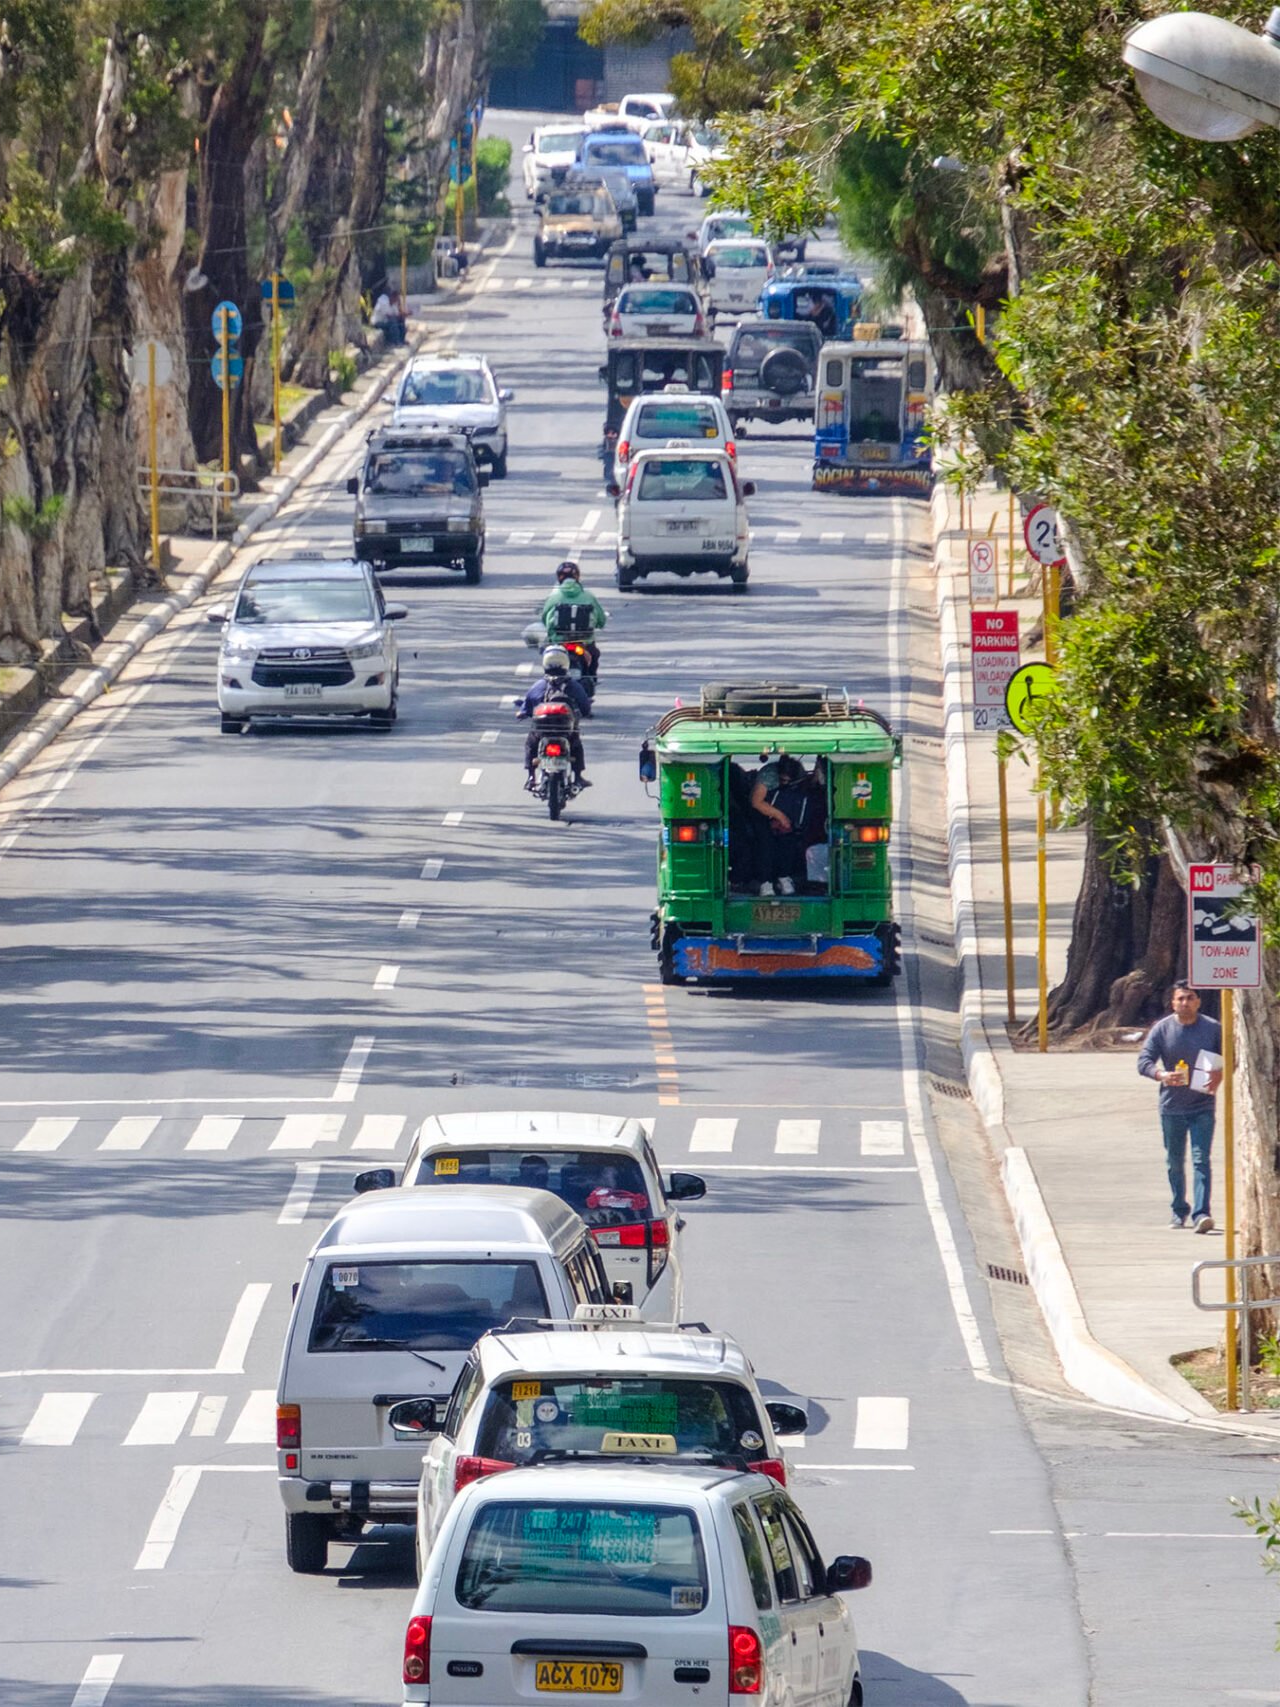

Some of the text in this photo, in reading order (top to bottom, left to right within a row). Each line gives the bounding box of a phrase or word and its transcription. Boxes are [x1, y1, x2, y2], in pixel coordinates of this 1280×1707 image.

[816, 467, 931, 487] SOCIAL DISTANCING
[986, 618, 1004, 630] NO
[975, 635, 1017, 648] PARKING
[976, 656, 1009, 667] LOADING
[976, 671, 1012, 682] UNLOADIN
[975, 708, 988, 726] 20
[1195, 872, 1213, 888] NO
[1200, 945, 1251, 958] TOW-AWAY
[1212, 967, 1239, 979] ZONE
[586, 1308, 629, 1319] TAXI
[517, 1432, 531, 1449] 03
[614, 1436, 661, 1449] TAXI
[674, 1659, 710, 1668] OPEN HERE
[539, 1665, 619, 1687] ACX 1079
